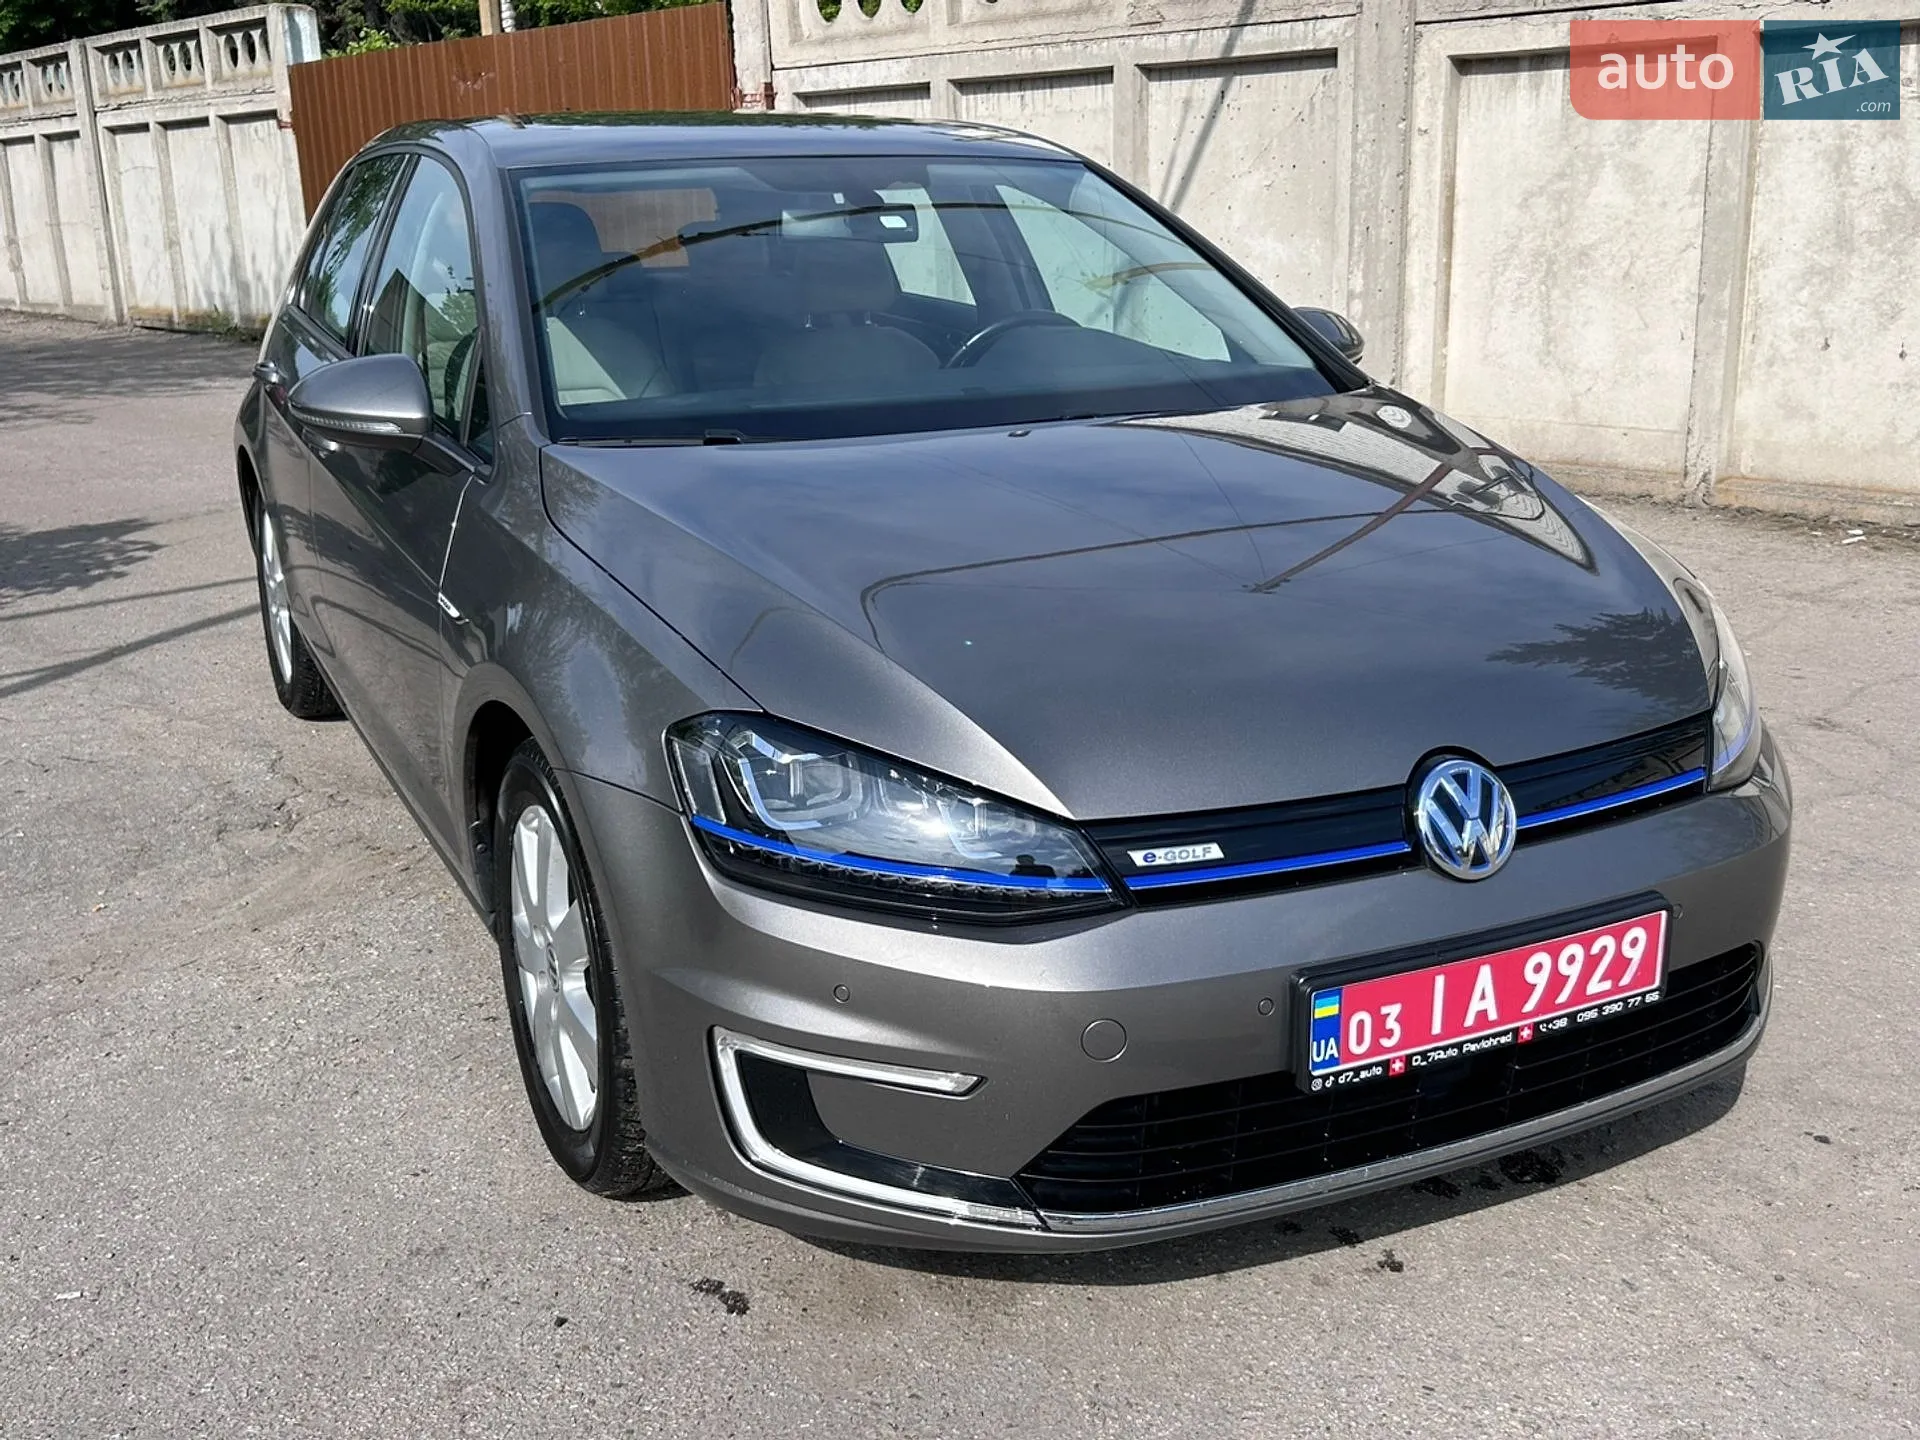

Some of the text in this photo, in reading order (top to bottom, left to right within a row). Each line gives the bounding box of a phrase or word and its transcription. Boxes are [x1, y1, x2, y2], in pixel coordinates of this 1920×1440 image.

[1142, 846, 1213, 863] e-GOLF
[1348, 926, 1648, 1056] 03 IA 9929
[1312, 1037, 1339, 1063] UA
